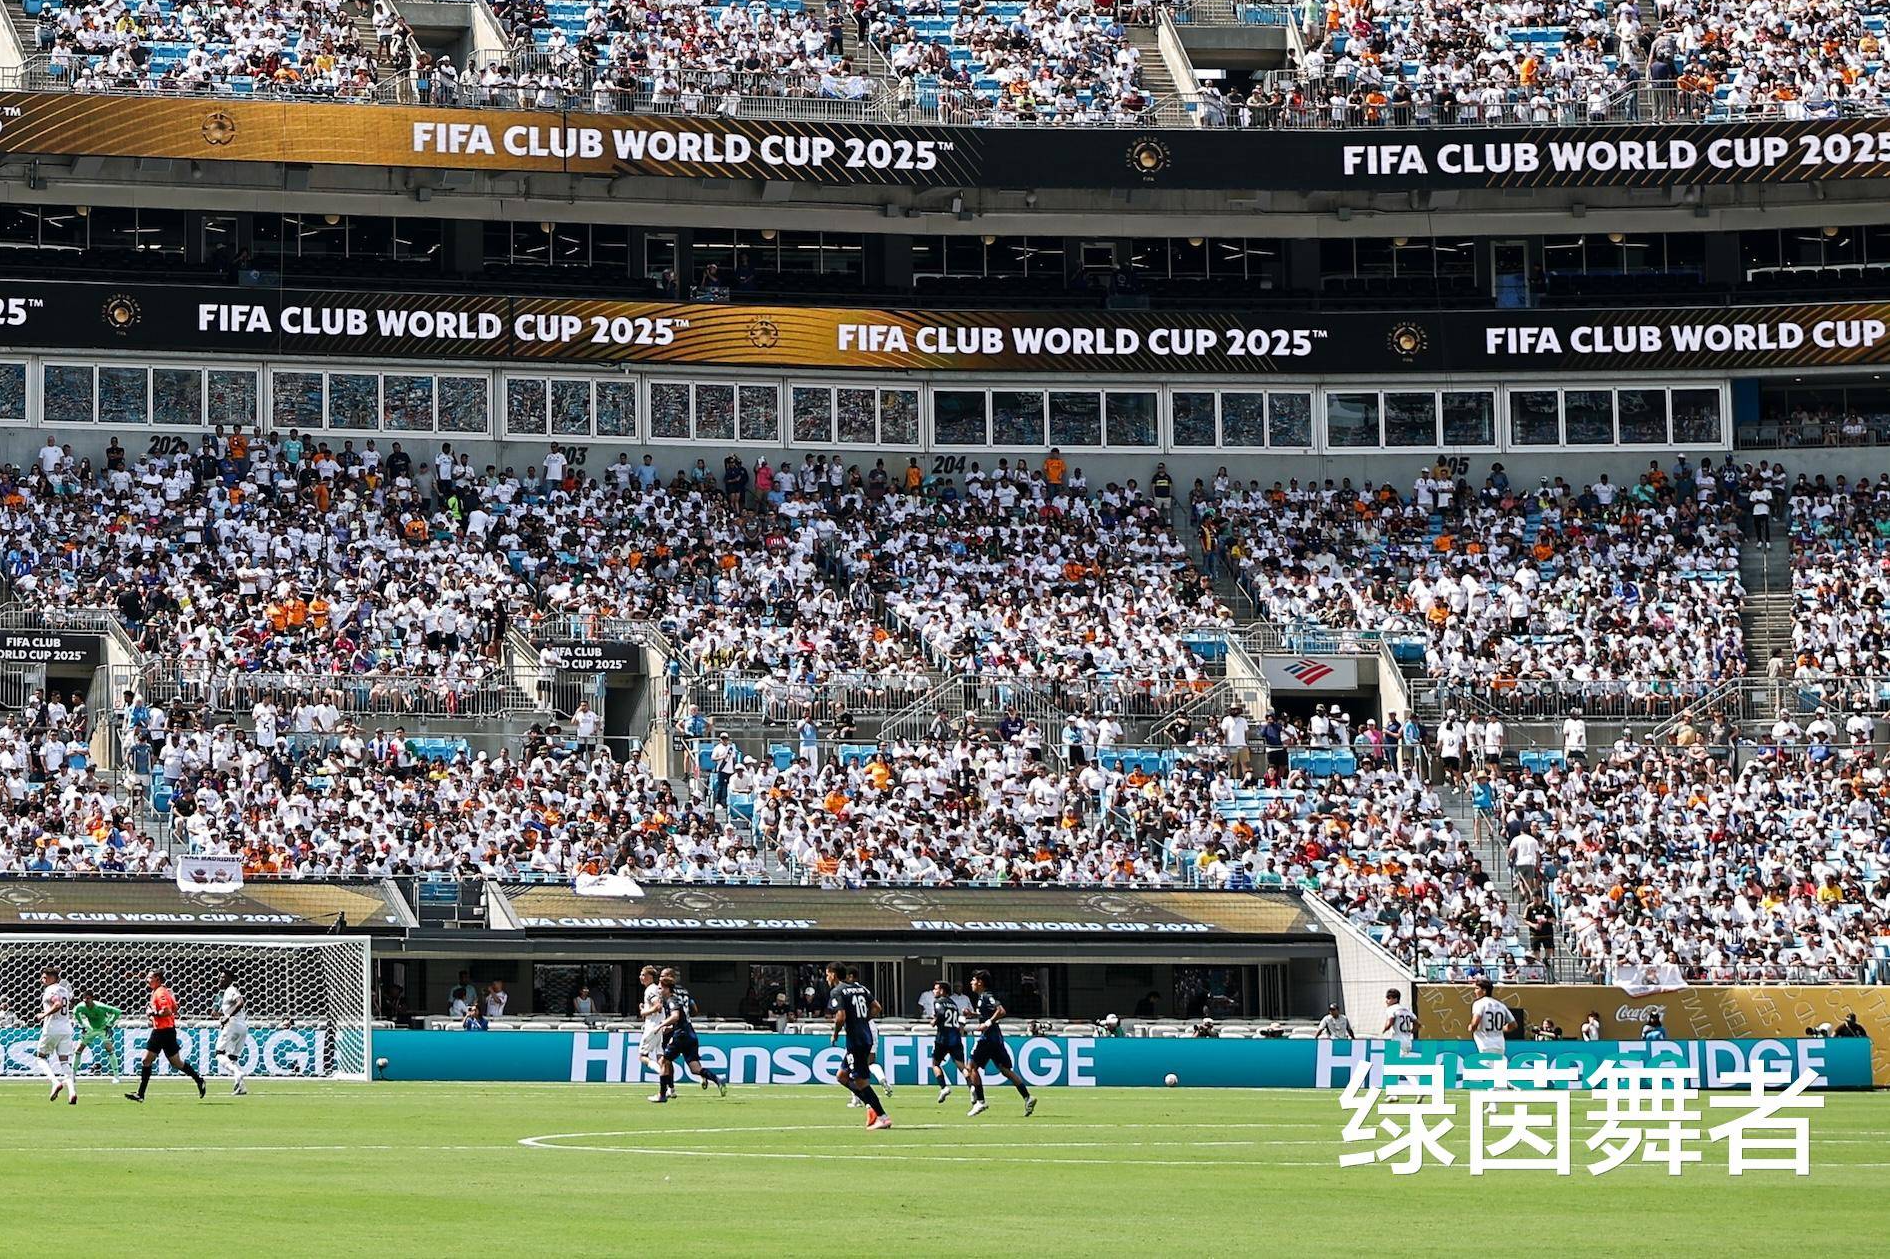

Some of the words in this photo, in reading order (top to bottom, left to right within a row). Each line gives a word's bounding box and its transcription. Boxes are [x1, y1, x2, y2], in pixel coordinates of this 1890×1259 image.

[414, 123, 495, 154] FIFA
[504, 126, 603, 157] CLUB
[613, 130, 751, 163] WORLD
[761, 135, 835, 166] CUP
[1344, 146, 1427, 174] FIFA
[1438, 143, 1539, 173] CLUB
[1549, 141, 1697, 171] WORLD
[1708, 137, 1788, 168] CUP
[839, 325, 909, 352] FIFA
[916, 327, 1003, 353] CLUB
[1012, 328, 1139, 354] WORLD
[1149, 329, 1217, 355] CUP
[1487, 328, 1562, 353] FIFA
[1571, 326, 1661, 352] CLUB
[1671, 323, 1803, 351] WORLD
[1813, 320, 1885, 347] CUP
[933, 455, 966, 474] 204
[6, 637, 30, 647] FIFA
[32, 637, 61, 648] CLUB
[574, 646, 602, 657] CLUB
[26, 649, 51, 660] CUP
[572, 658, 593, 669] CUP
[20, 912, 63, 921] FIFA
[67, 912, 118, 921] CLUB
[121, 913, 194, 922] WORLD
[199, 913, 238, 922] CUP
[852, 994, 868, 1018] 16
[1485, 1011, 1504, 1032] 30
